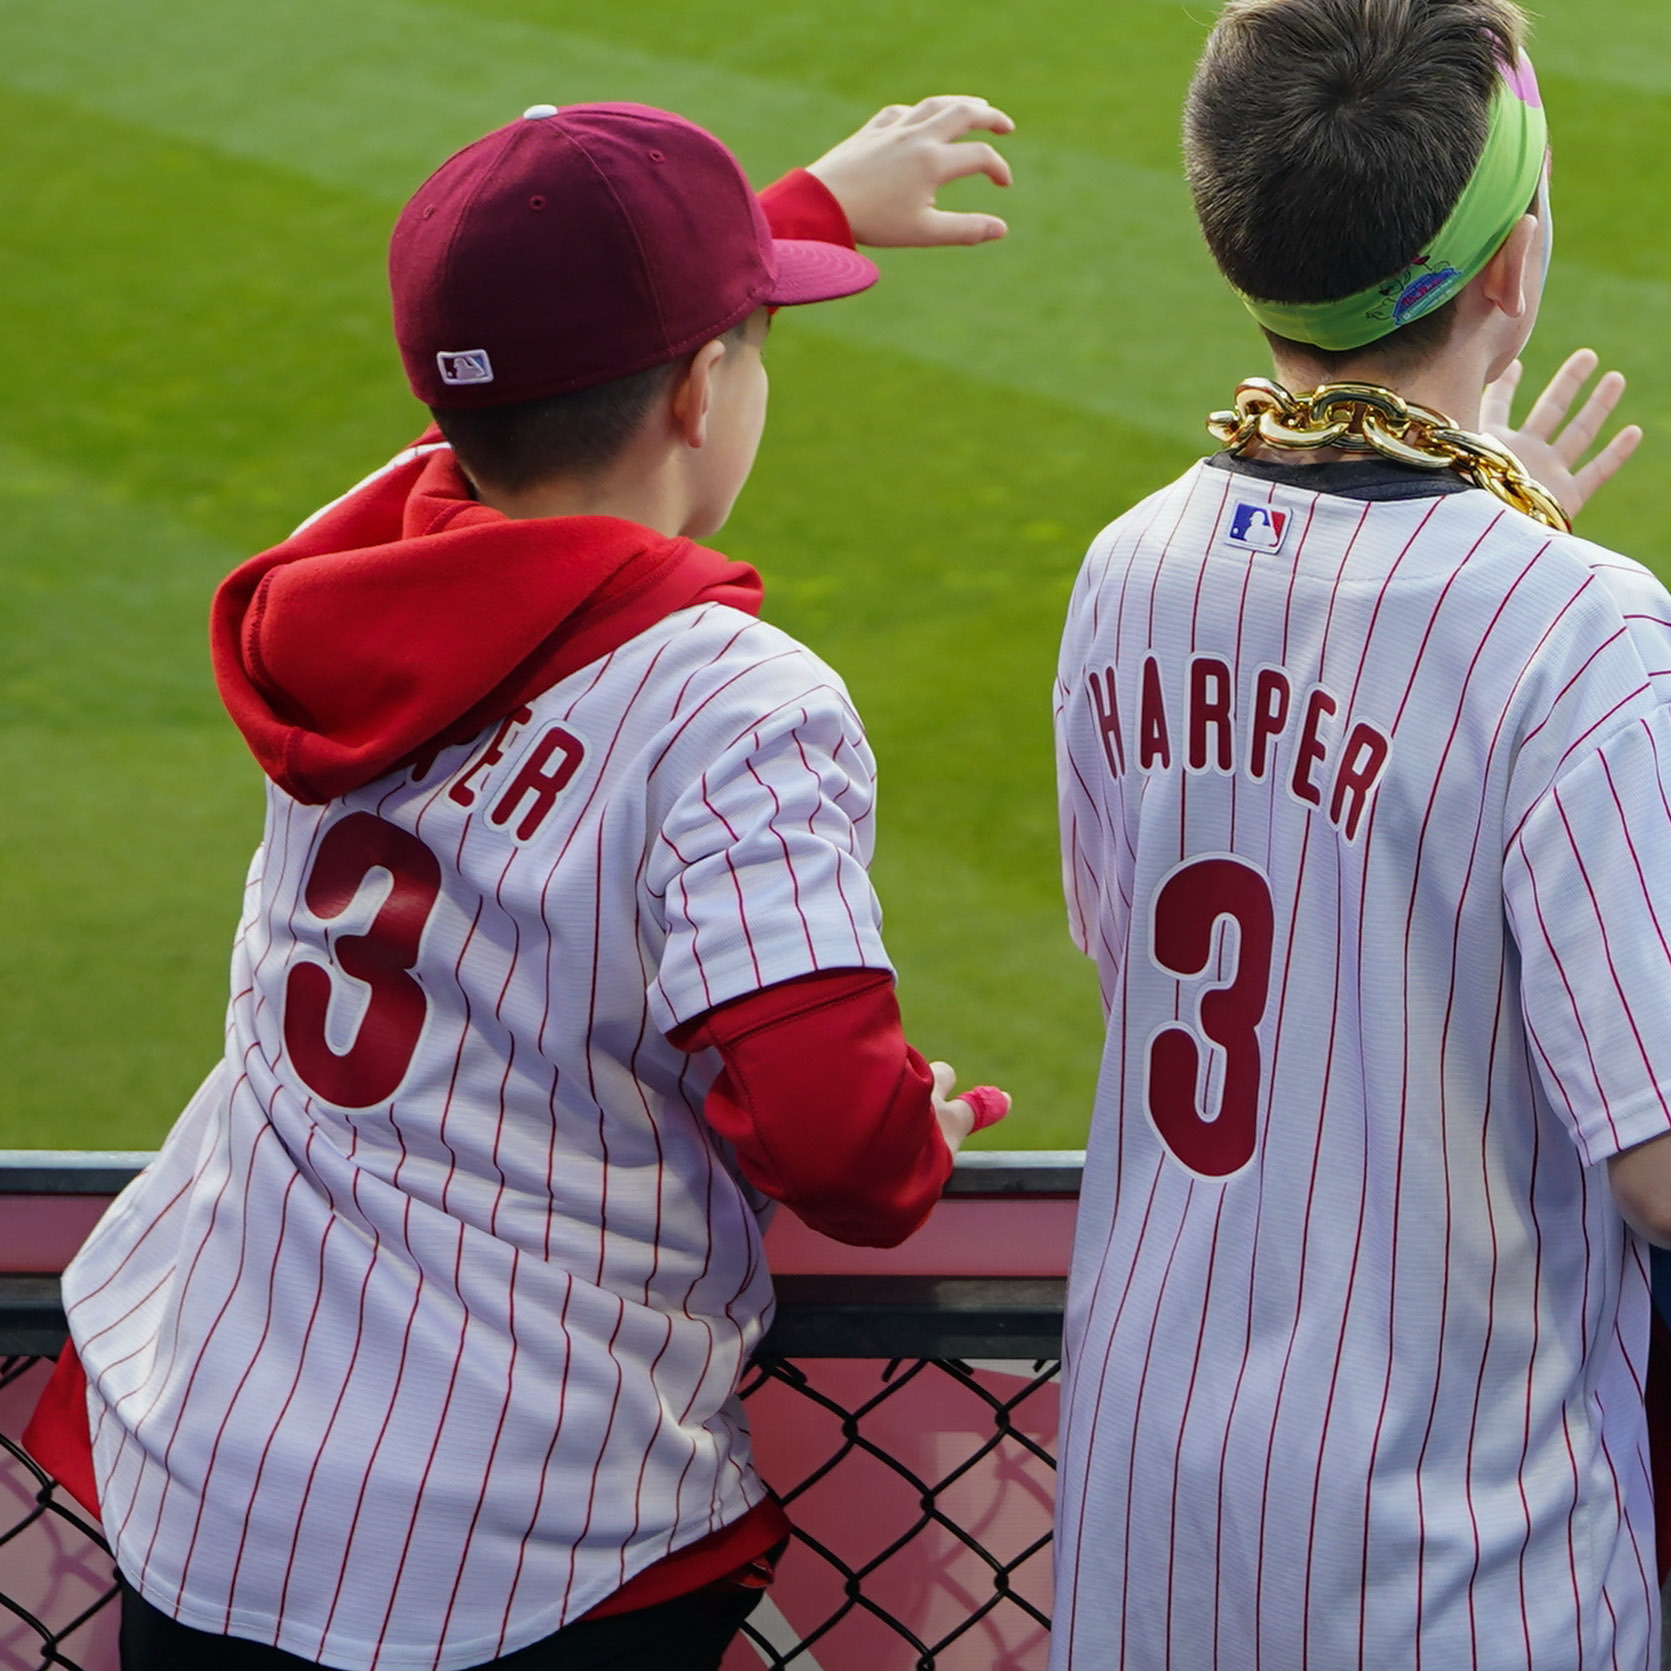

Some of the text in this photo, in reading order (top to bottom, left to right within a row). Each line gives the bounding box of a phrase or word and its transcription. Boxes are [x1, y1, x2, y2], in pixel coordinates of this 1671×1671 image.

[1088, 652, 1393, 845] HARPER
[282, 810, 444, 1112] 3
[1144, 852, 1276, 1182] 3
